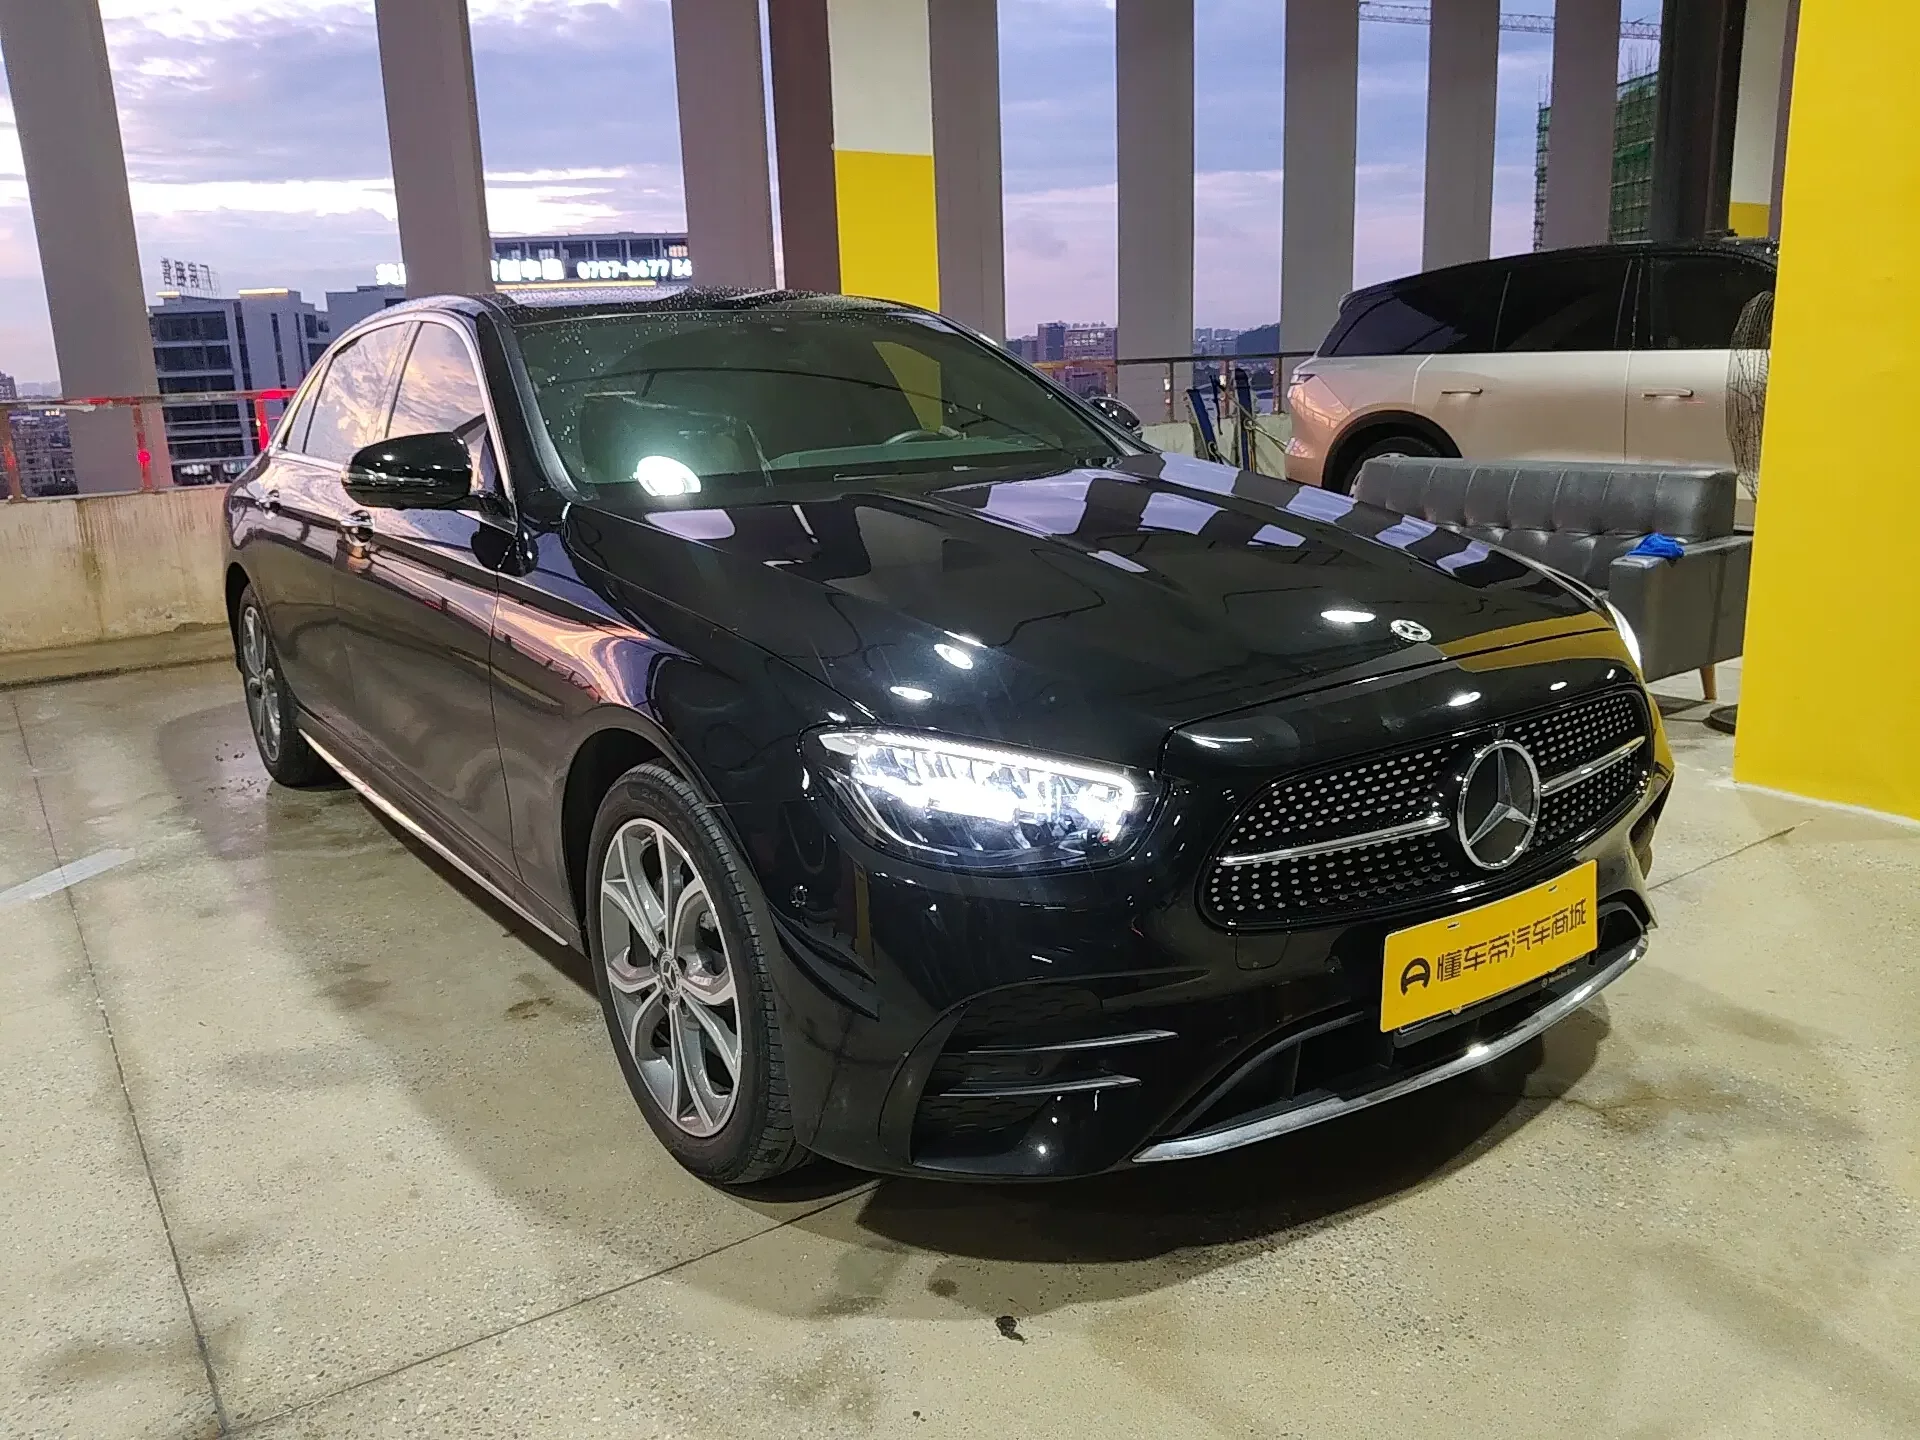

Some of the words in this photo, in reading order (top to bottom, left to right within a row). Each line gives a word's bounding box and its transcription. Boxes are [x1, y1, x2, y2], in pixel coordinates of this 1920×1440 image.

[1437, 898, 1588, 982] 懂车帝汽车商城
